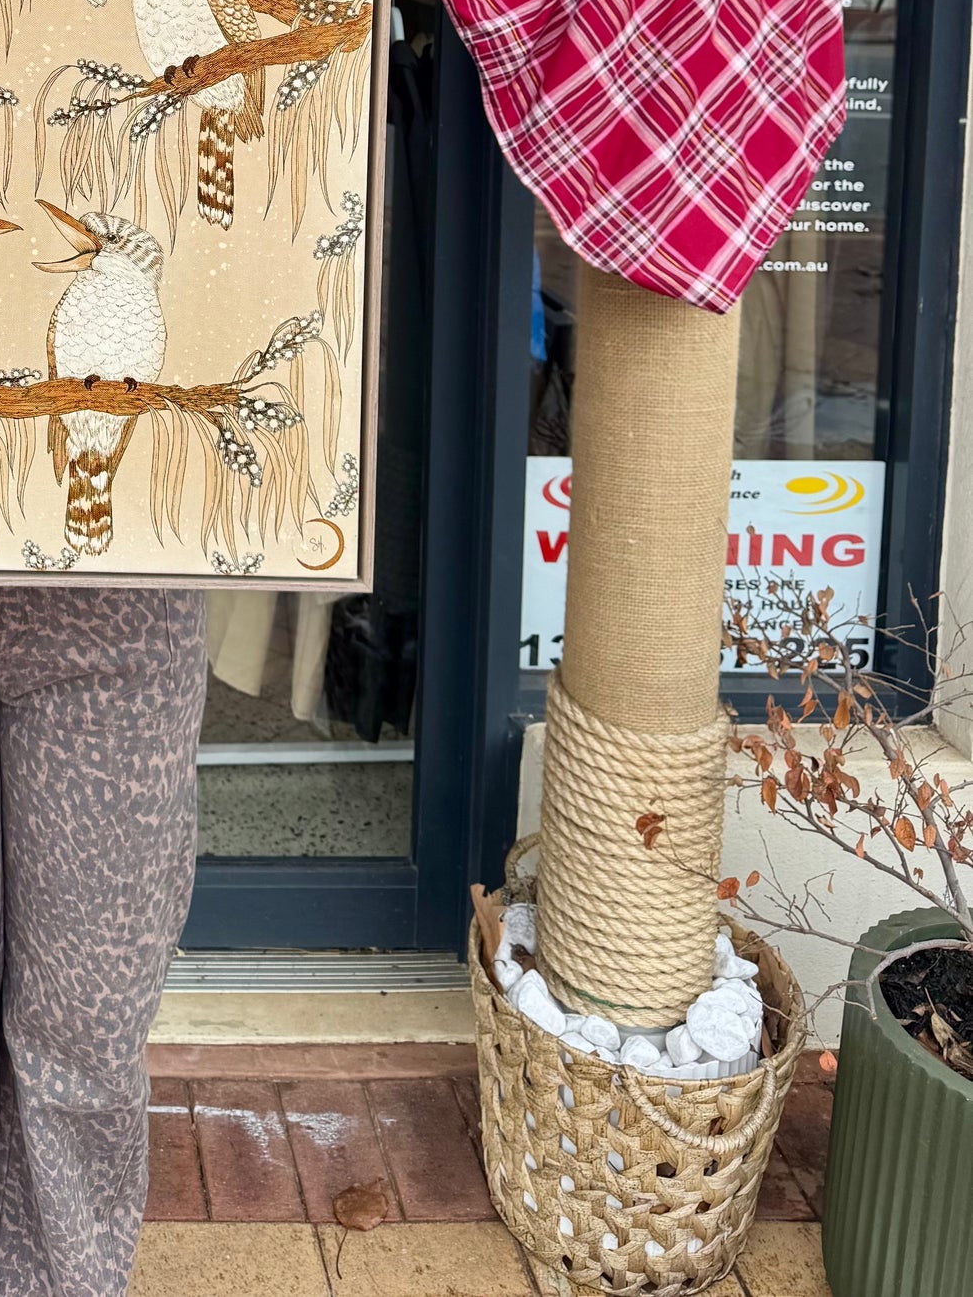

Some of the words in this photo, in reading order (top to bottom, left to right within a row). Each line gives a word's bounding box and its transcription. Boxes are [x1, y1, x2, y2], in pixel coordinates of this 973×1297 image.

[845, 77, 889, 93] fully
[845, 97, 882, 112] ind.
[824, 159, 855, 172] the
[811, 181, 832, 192] or
[834, 179, 865, 192] the
[814, 219, 870, 233] home.
[758, 261, 829, 273] .com.au
